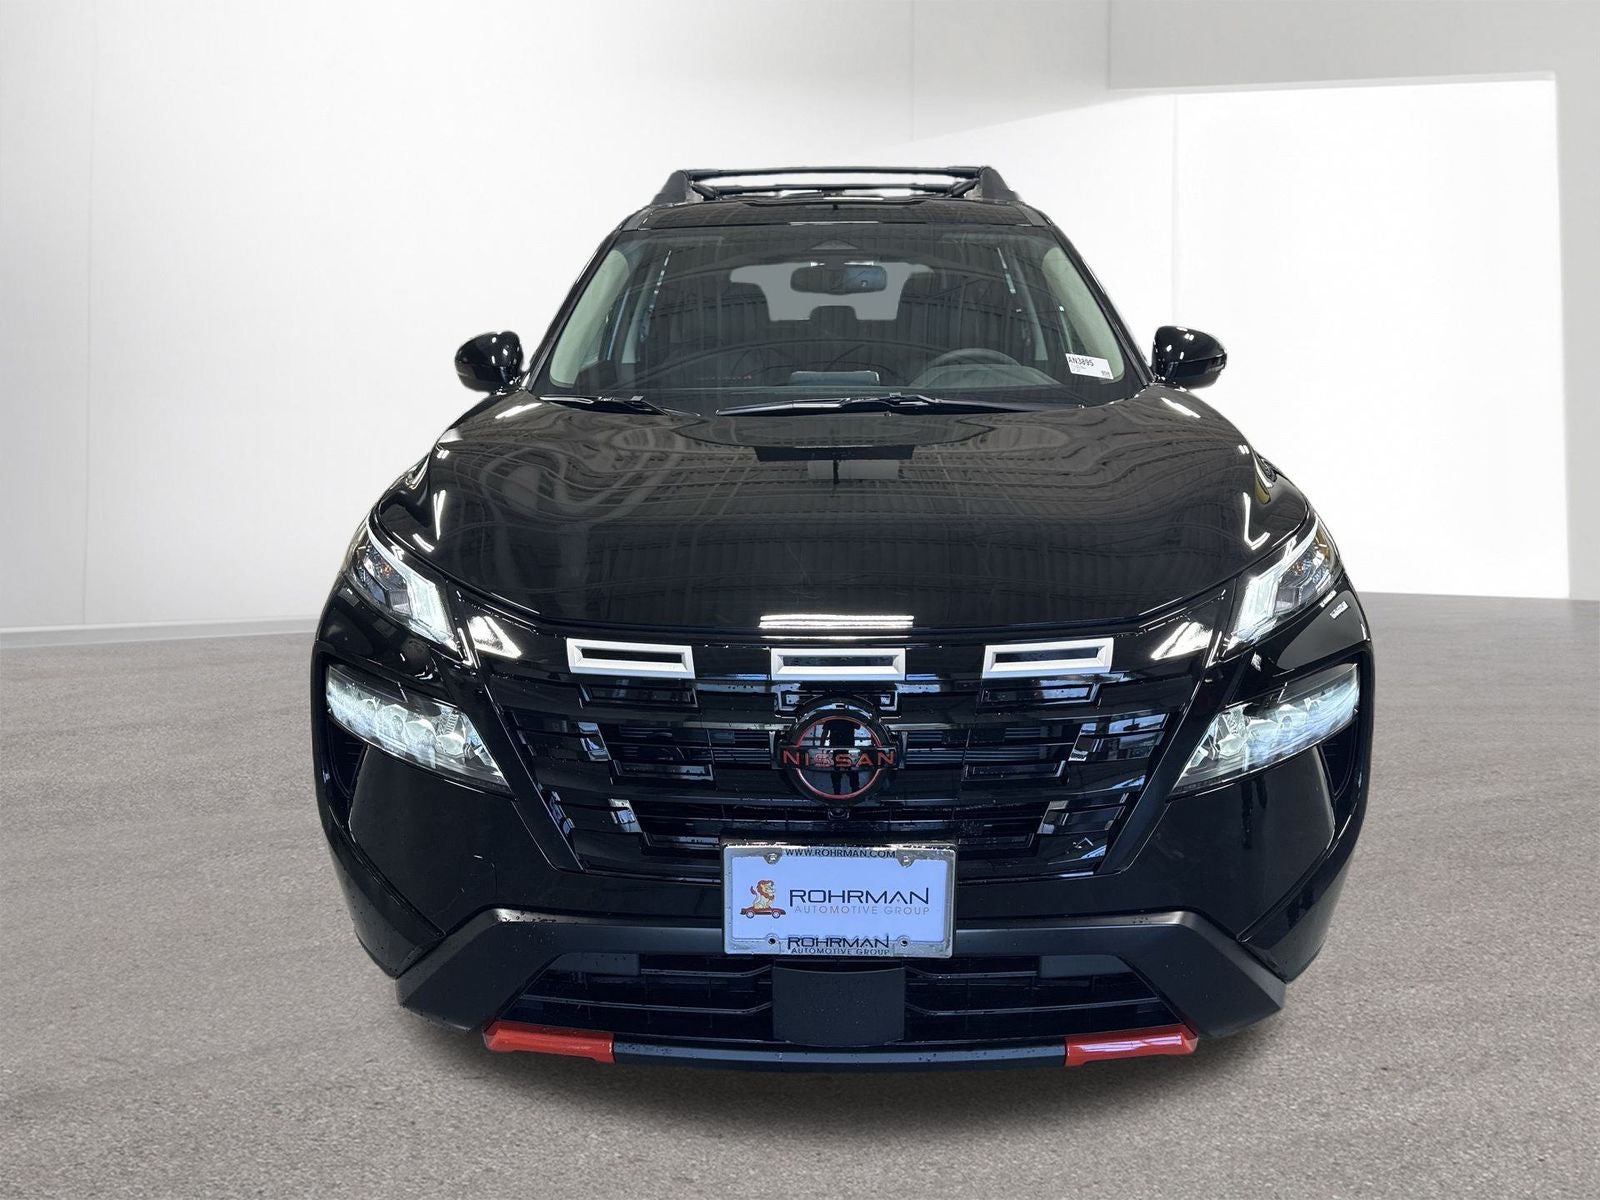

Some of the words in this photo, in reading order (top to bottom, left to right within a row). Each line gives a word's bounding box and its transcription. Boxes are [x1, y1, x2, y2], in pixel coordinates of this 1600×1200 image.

[783, 750, 895, 767] NISSAN
[785, 848, 896, 858] WWW.ROHRMAN.COM
[789, 887, 930, 907] ROHRMAN
[794, 905, 878, 915] AUTOMOTIVE
[884, 906, 930, 915] GROUP
[787, 934, 889, 949] ROHRMAN
